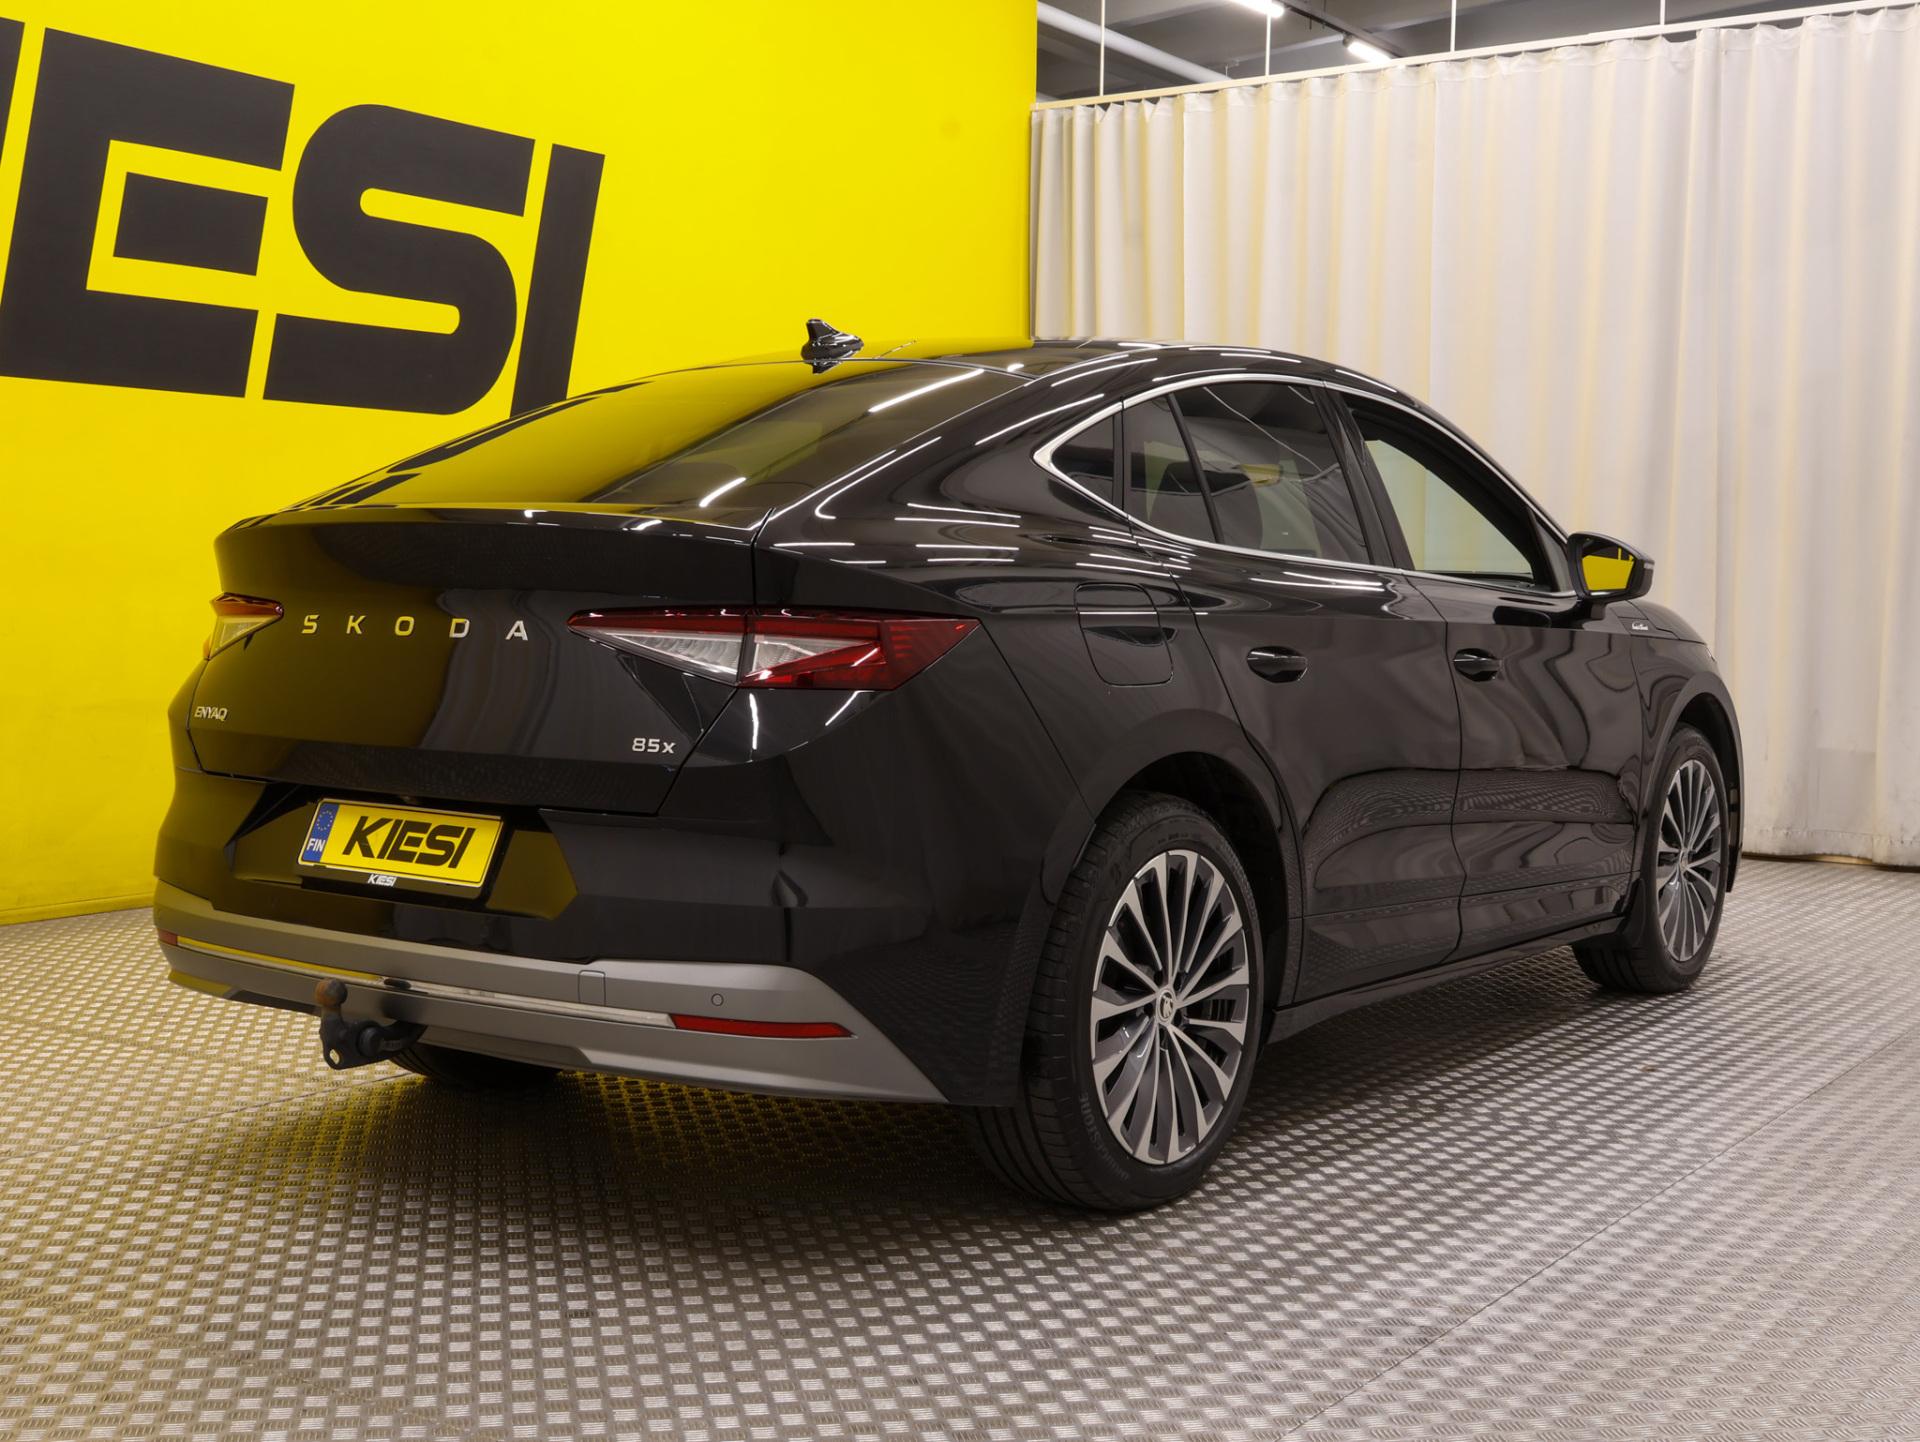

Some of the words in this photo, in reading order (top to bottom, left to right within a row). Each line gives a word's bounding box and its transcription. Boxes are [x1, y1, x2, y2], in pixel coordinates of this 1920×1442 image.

[0, 17, 606, 419] ESI
[301, 614, 529, 641] SKODA
[194, 705, 228, 722] ENYAQ
[306, 837, 327, 852] FIN
[342, 815, 477, 869] KIESI
[367, 873, 398, 887] KIESI
